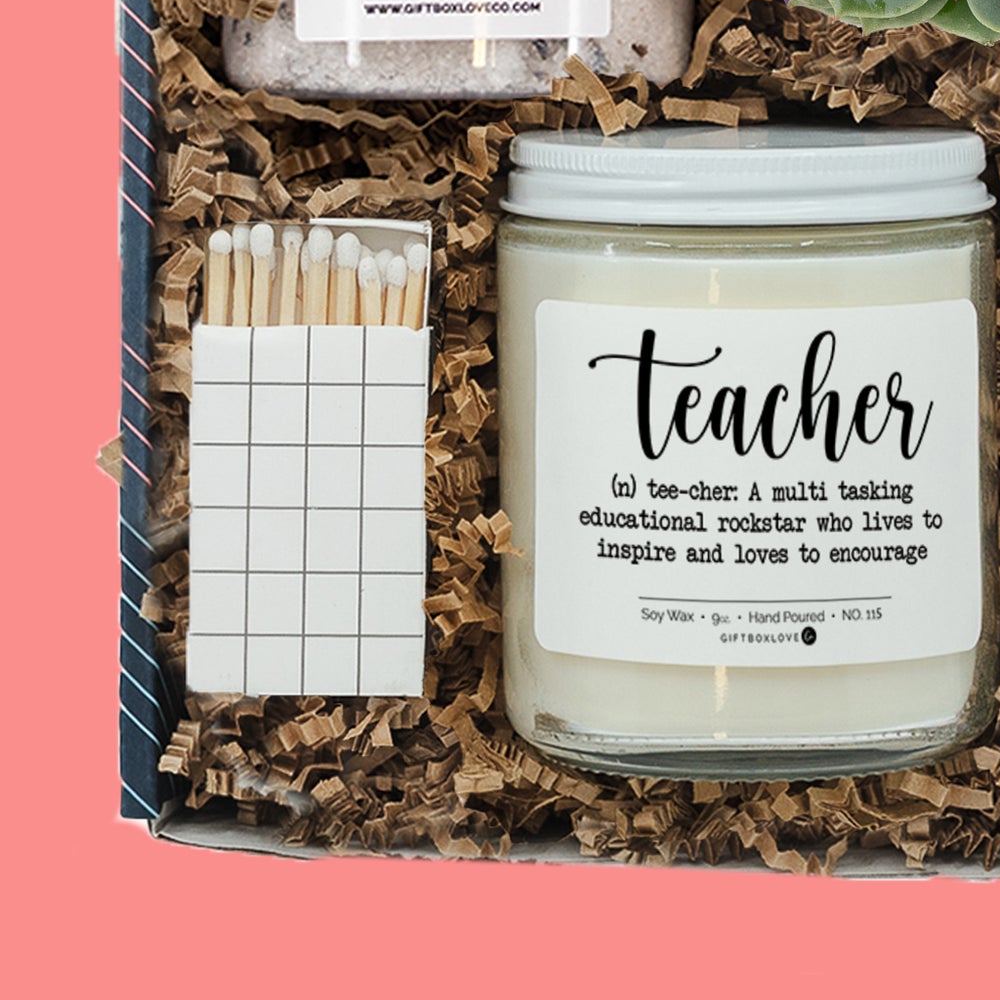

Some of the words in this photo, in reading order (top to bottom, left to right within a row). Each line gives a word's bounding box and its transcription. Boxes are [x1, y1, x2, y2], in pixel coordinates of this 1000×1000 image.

[587, 328, 934, 463] teacher
[610, 473, 637, 501] (n)
[646, 476, 739, 503] tee-cher:
[747, 481, 762, 502] A
[770, 479, 829, 503] multi
[837, 479, 914, 505] tasking
[578, 506, 707, 534] educational
[717, 508, 807, 534] rockstar
[815, 509, 853, 532] who
[860, 509, 913, 532] lives
[922, 510, 944, 530] to
[596, 539, 676, 567] inspire
[684, 543, 725, 565] and
[734, 543, 789, 565] loves
[797, 544, 821, 565] to
[828, 542, 928, 566] encourage
[640, 607, 664, 624] Soy
[666, 608, 694, 623] Wax
[746, 610, 780, 624] Hand
[782, 609, 825, 624] Poured
[865, 606, 882, 620] 115
[719, 631, 799, 644] GIFTBOXLOVE
